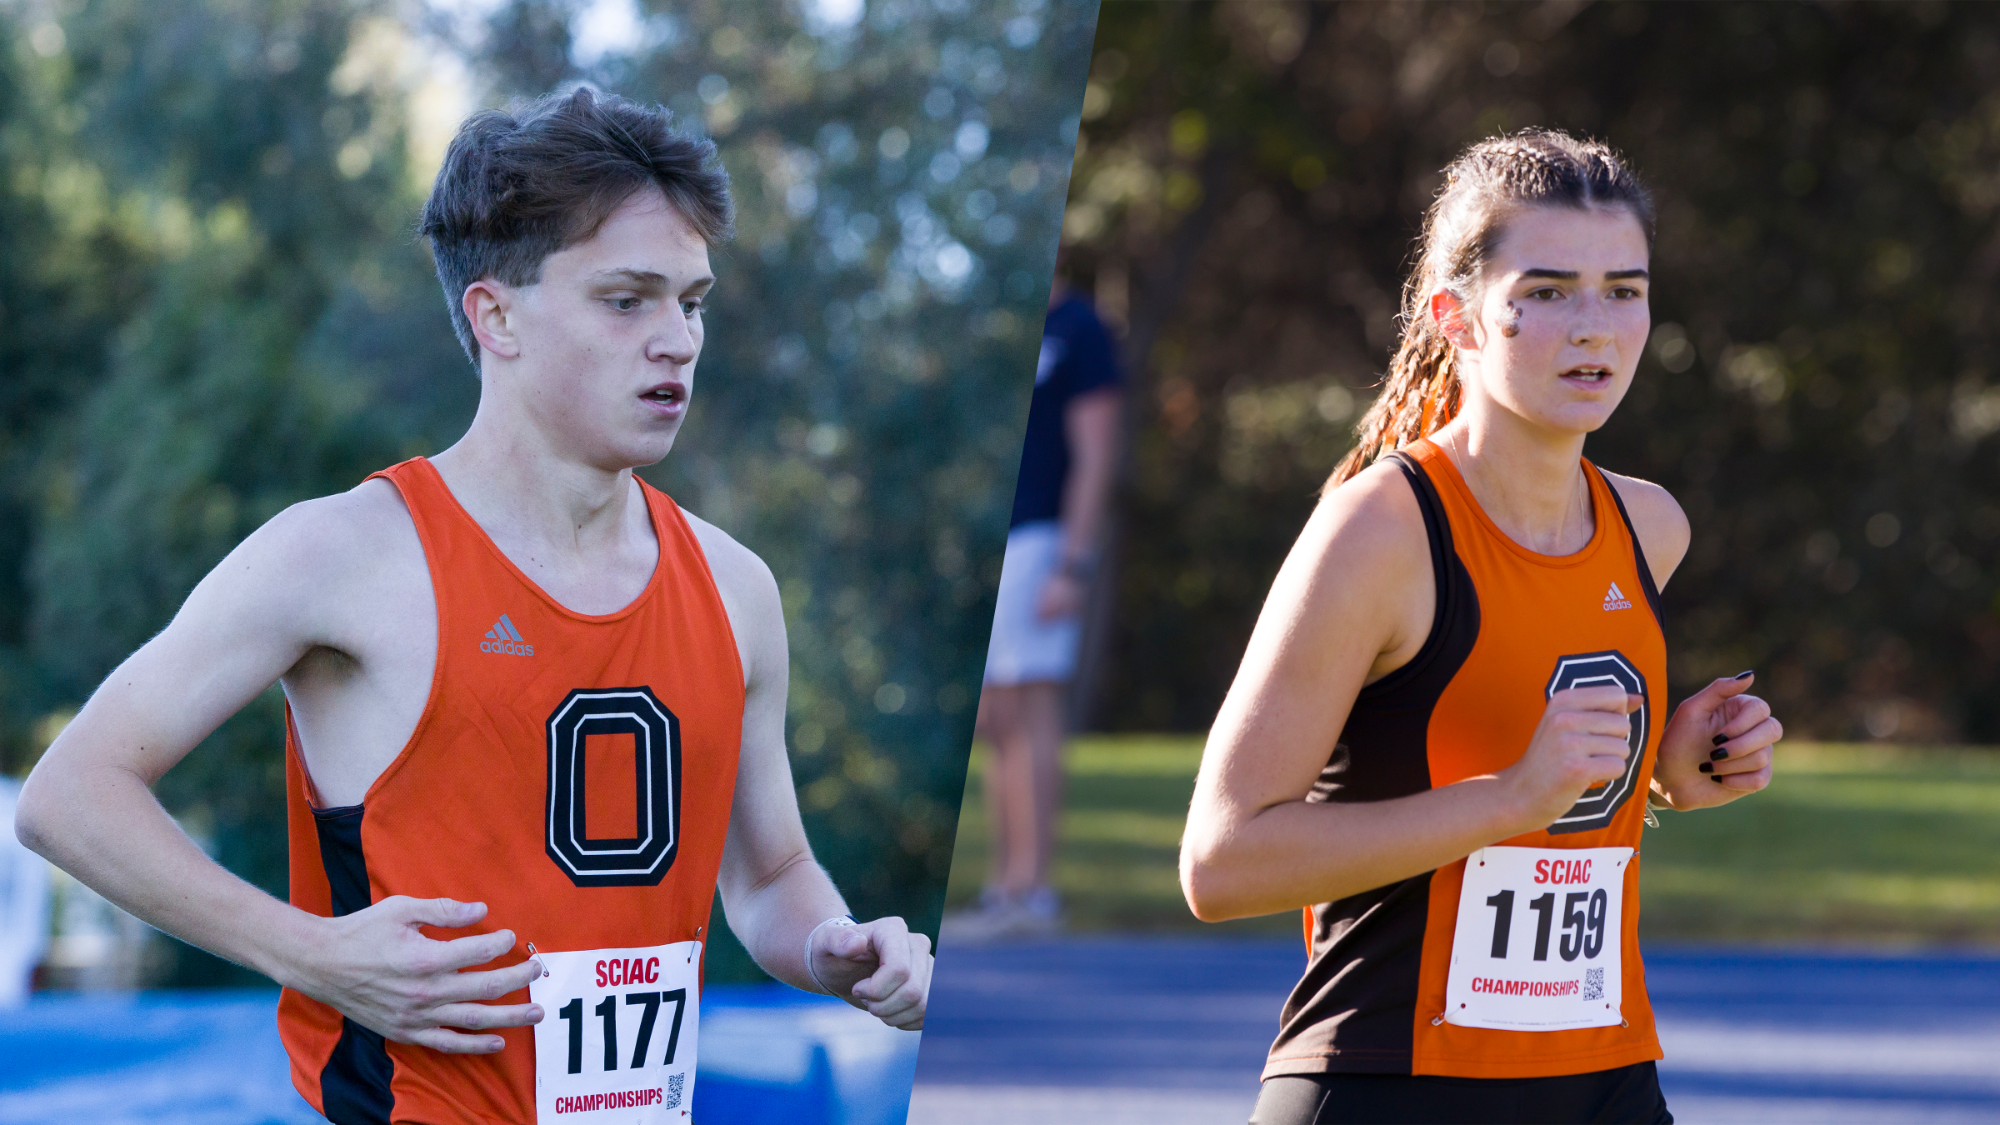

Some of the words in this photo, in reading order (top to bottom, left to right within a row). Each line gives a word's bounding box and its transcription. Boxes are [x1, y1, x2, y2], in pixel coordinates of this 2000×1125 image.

[1603, 600, 1632, 611] adidas
[479, 638, 534, 657] adidas
[1534, 859, 1592, 885] SCIAC
[1486, 888, 1607, 962] 1159
[596, 957, 660, 987] SCIAC
[1471, 977, 1579, 997] CHAMPIONSHIPS
[559, 988, 686, 1074] 1177
[555, 1088, 662, 1114] CHAMPIONSHIPS
